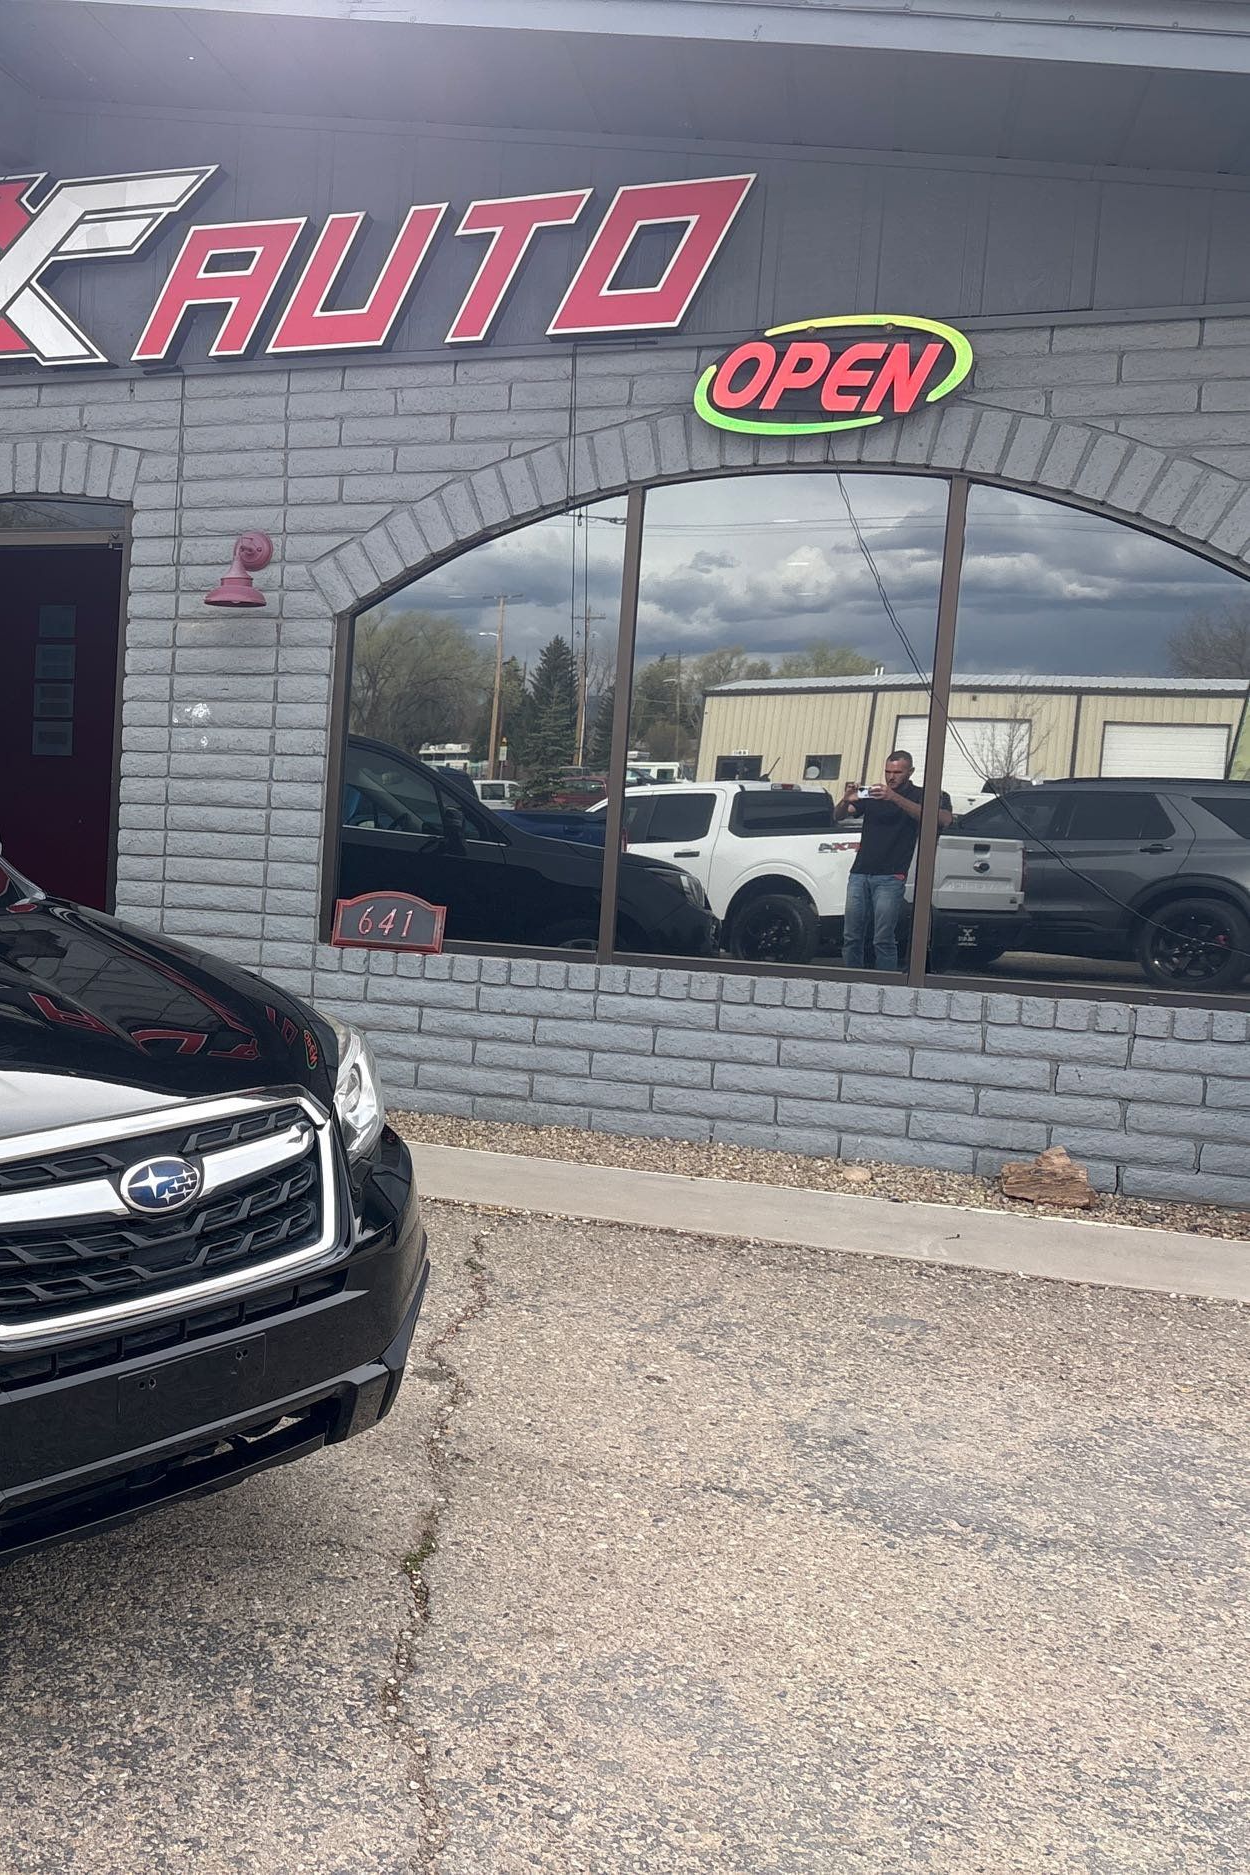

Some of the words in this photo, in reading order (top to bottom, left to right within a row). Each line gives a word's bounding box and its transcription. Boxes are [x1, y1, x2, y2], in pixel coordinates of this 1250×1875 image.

[132, 173, 757, 360] AUTO
[712, 341, 946, 414] OPEN
[358, 905, 414, 938] 641
